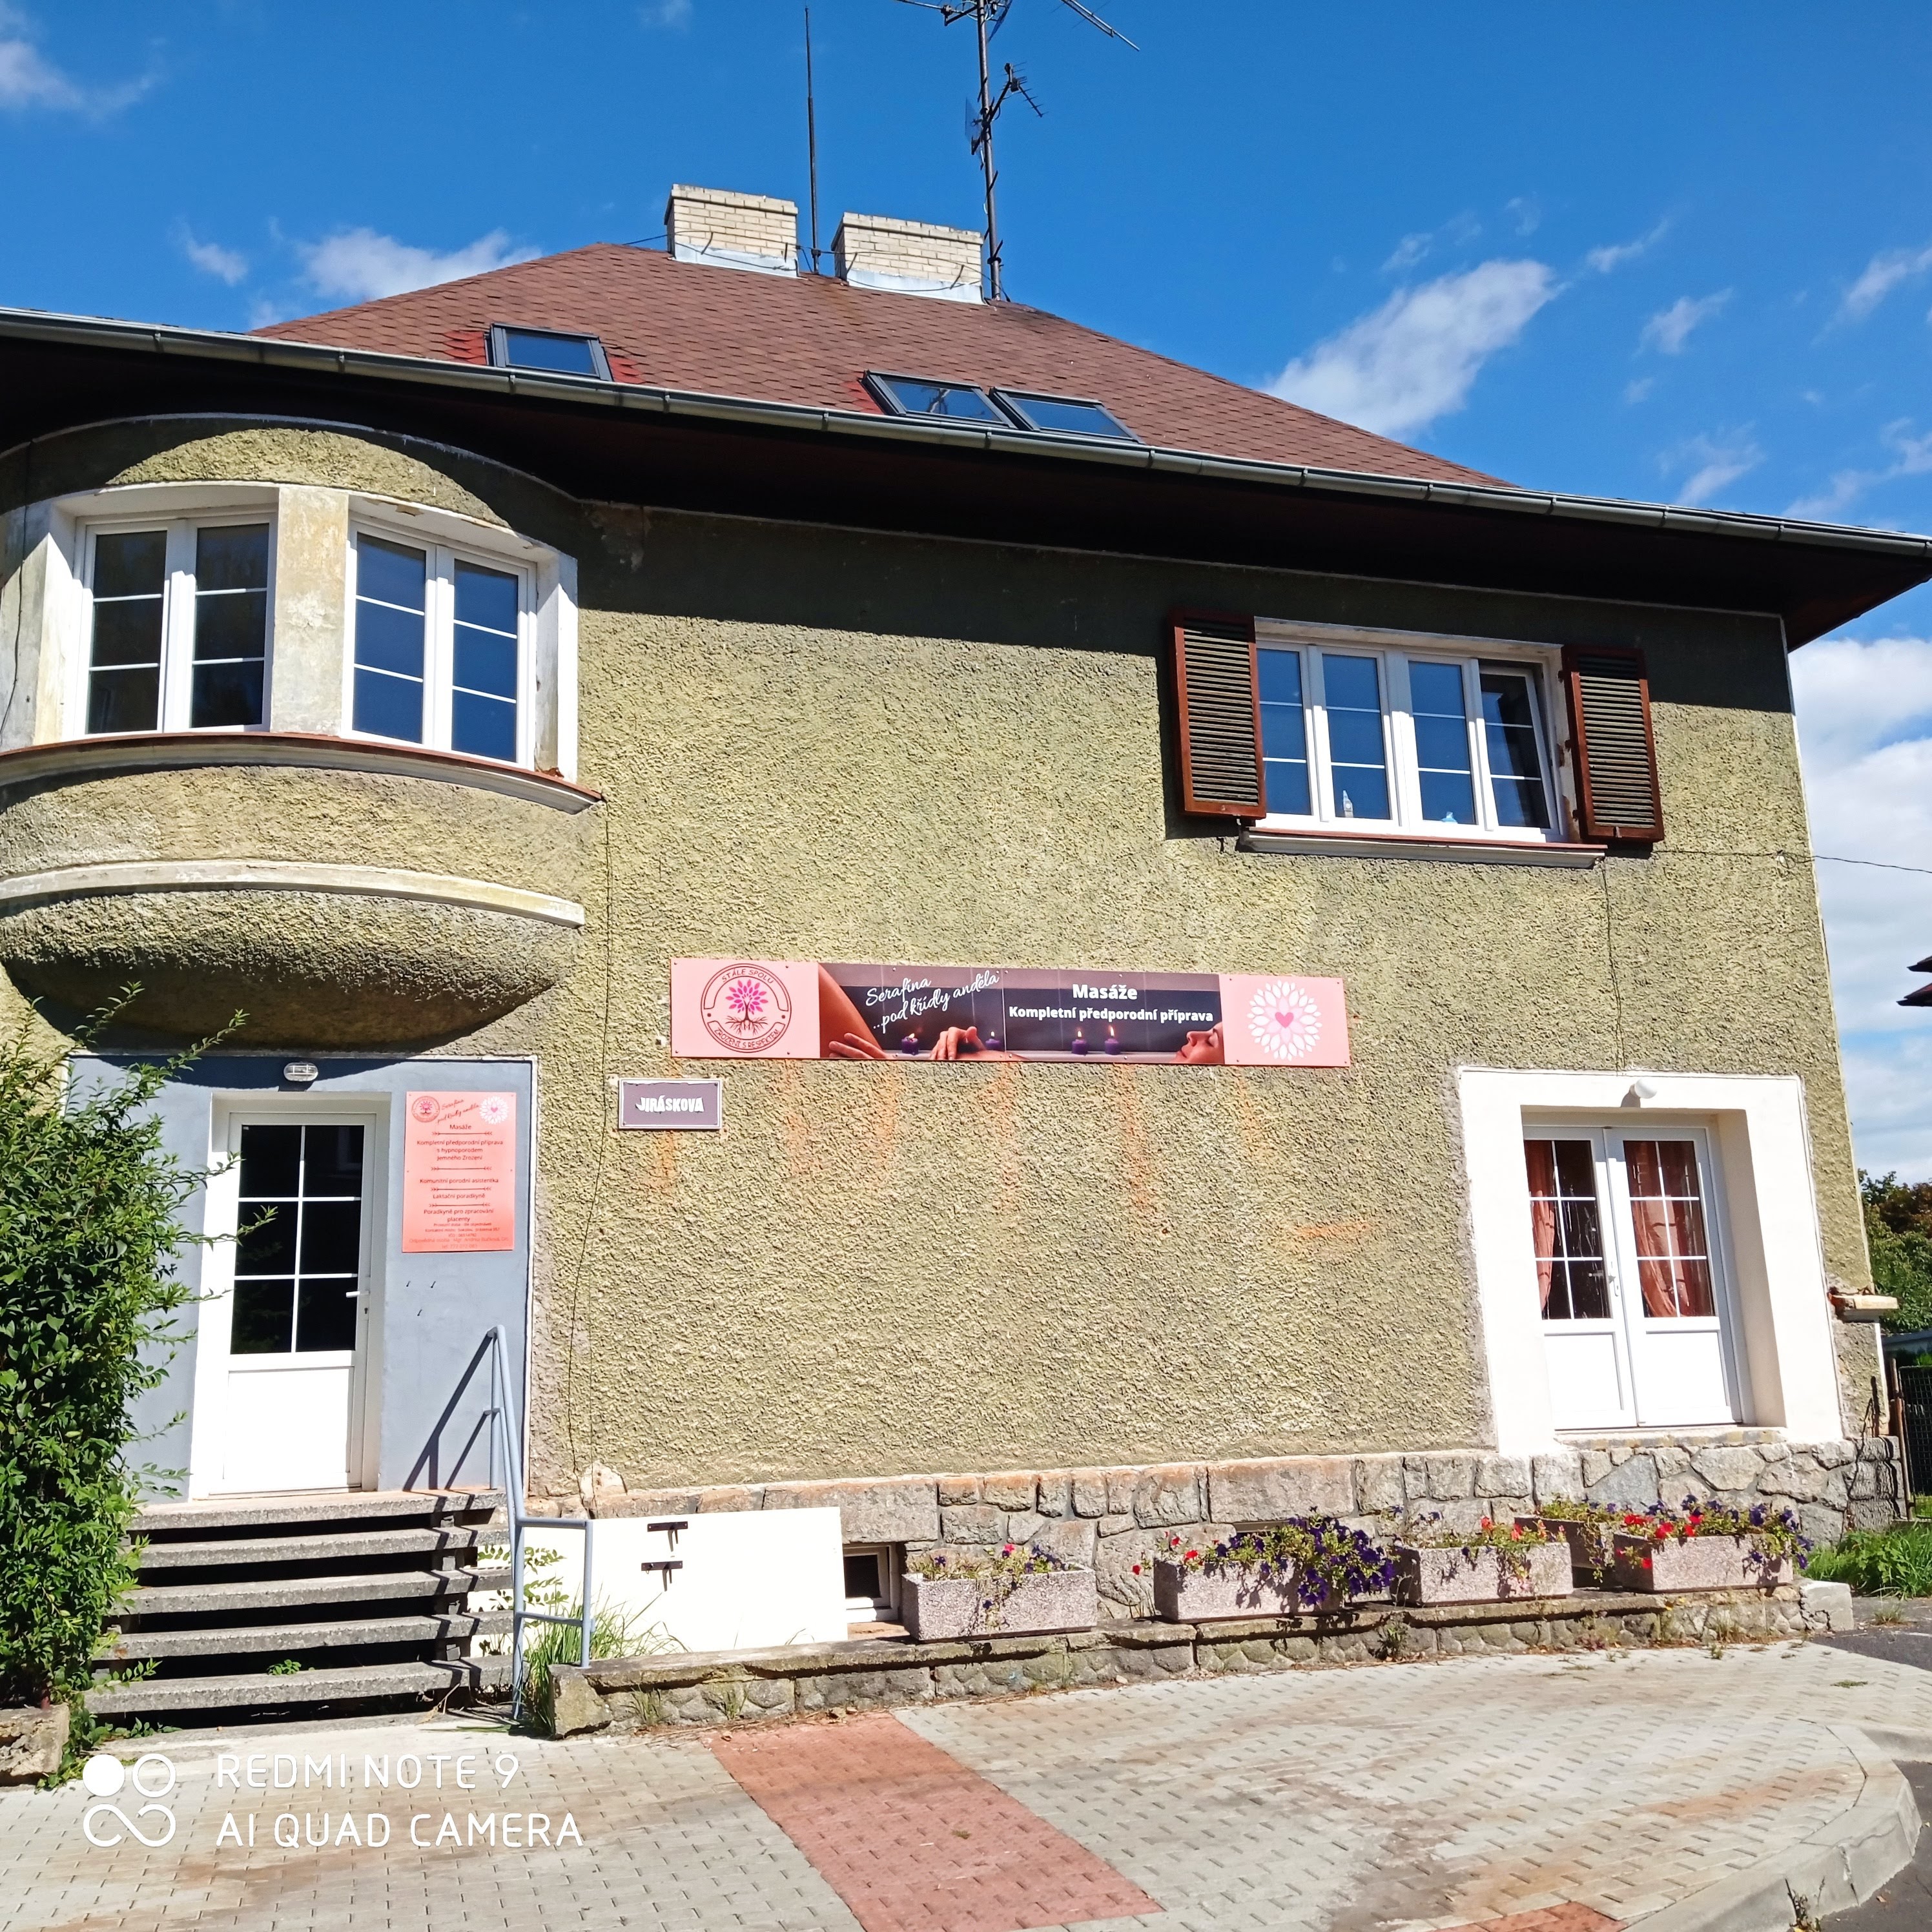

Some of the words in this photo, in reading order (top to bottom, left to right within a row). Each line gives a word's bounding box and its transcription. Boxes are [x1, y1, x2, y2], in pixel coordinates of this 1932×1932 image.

[721, 968, 746, 983] STÁLE
[748, 969, 774, 984] SPOLU
[865, 977, 932, 1006] Serafina
[910, 989, 951, 1016] křídly
[952, 970, 1000, 998] anděla
[1072, 983, 1138, 1000] Masáže
[1009, 1006, 1077, 1022] Kompletní
[1079, 1007, 1158, 1022] předporodní
[1160, 1010, 1213, 1024] příprava
[635, 1094, 704, 1113] JIRÁSKOVA
